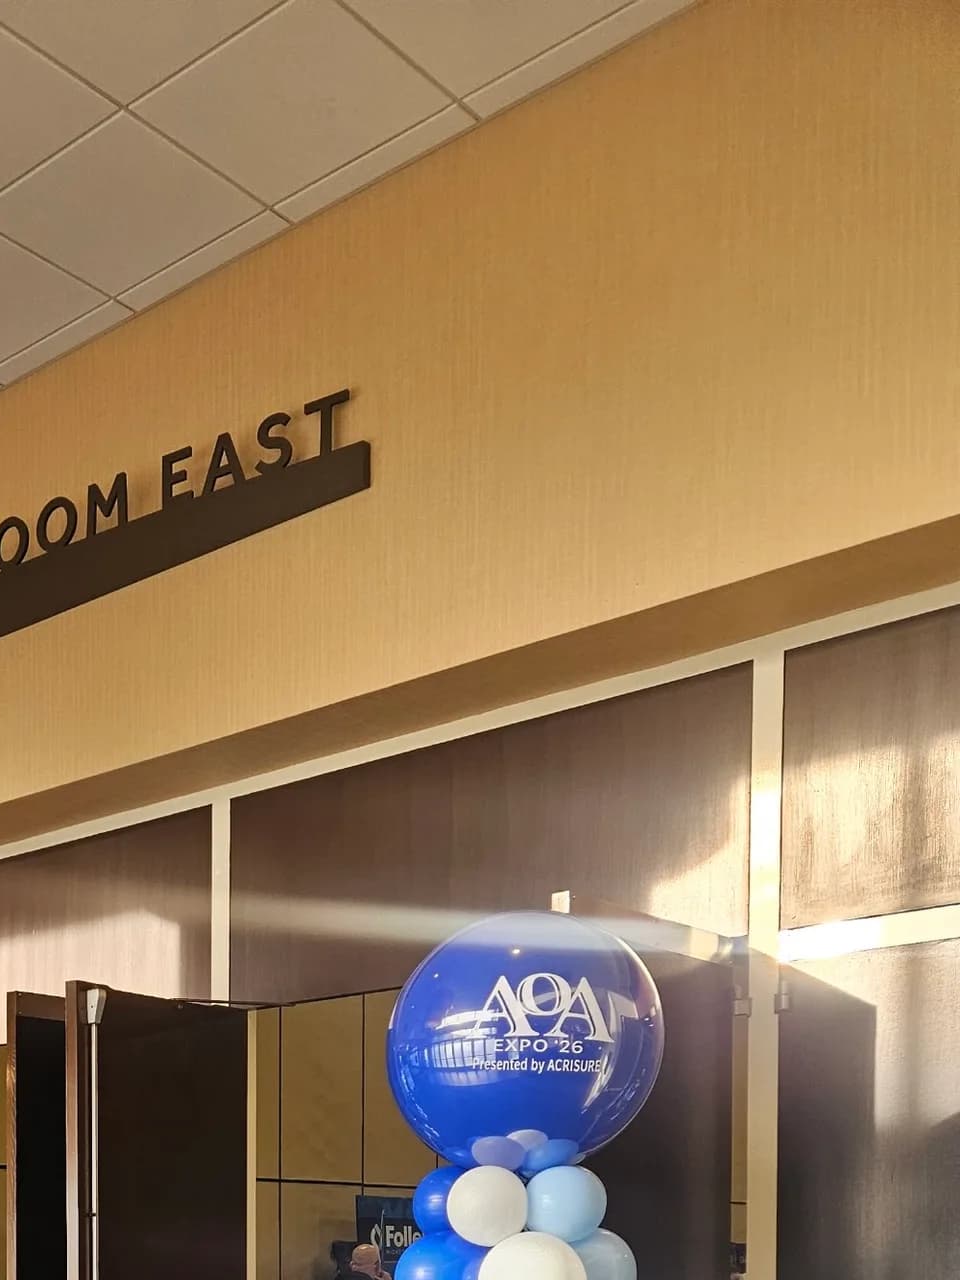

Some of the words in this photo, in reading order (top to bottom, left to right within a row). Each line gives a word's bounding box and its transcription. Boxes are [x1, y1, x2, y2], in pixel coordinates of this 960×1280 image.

[161, 388, 351, 509] EAST
[464, 972, 616, 1043] AOA
[472, 1057, 528, 1072] Presented
[531, 1057, 544, 1074] by
[547, 1058, 602, 1072] ACRISURE
[494, 1038, 548, 1053] EXPO
[554, 1039, 584, 1054] '26
